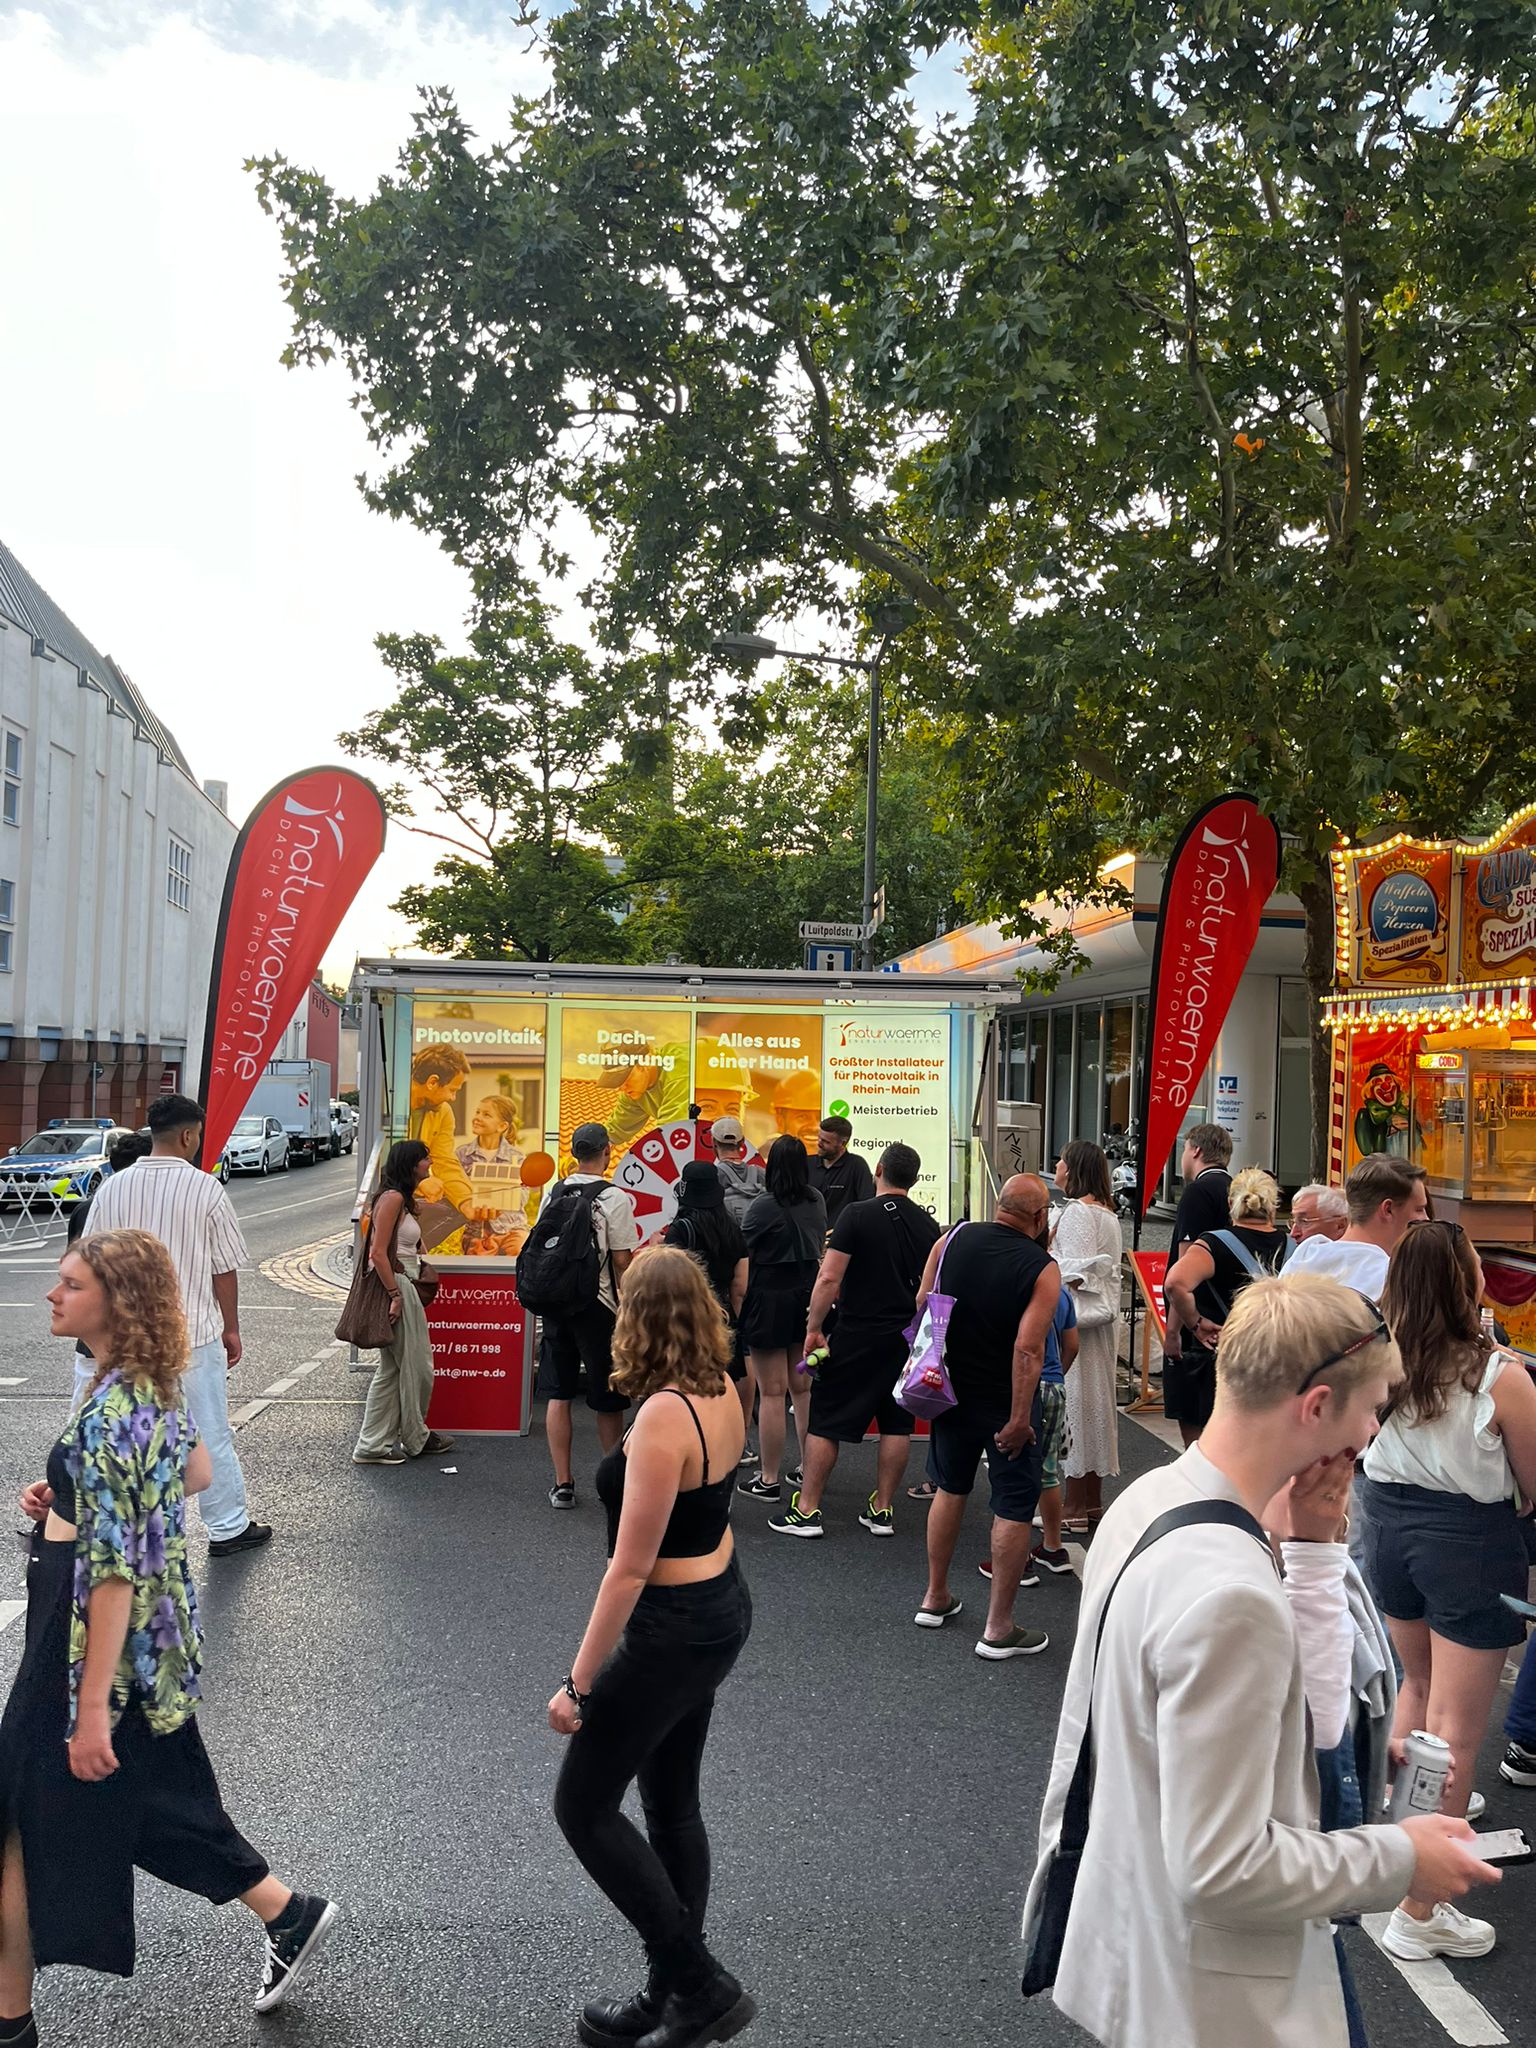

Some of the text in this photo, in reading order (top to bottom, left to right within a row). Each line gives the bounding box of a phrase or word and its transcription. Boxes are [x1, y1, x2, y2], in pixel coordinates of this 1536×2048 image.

[1384, 882, 1428, 900] Waffeln
[1379, 899, 1429, 916] Popcorn
[1382, 915, 1424, 930] Herzen
[808, 925, 854, 937] Luitpoldstr.
[212, 819, 292, 1077] DACH & PHOTOVOLTAIK
[233, 823, 325, 1081] naturwaerme
[1371, 934, 1428, 957] Spezialitäten
[1150, 850, 1209, 1104] DACH & PHOTOVOLTAIK
[1168, 852, 1236, 1108] naturwaerme
[415, 1027, 543, 1045] Photovoltaik
[597, 1029, 655, 1045] Dach-
[848, 1025, 942, 1039] naturwaerme
[717, 1033, 801, 1050] Alles aus
[577, 1050, 676, 1072] sanierung
[708, 1053, 809, 1070] einer Hand
[829, 1057, 944, 1068] Größter Installateur
[834, 1070, 939, 1081] für Photovoltaik in
[852, 1084, 920, 1095] Rhein-Main
[853, 1105, 938, 1116] Meisterbetrieb
[434, 1284, 519, 1300] turwaerm
[455, 1345, 468, 1354] 86
[470, 1345, 480, 1353] 71
[481, 1345, 501, 1354] 998
[433, 1367, 506, 1379] akt@nw-e.de
